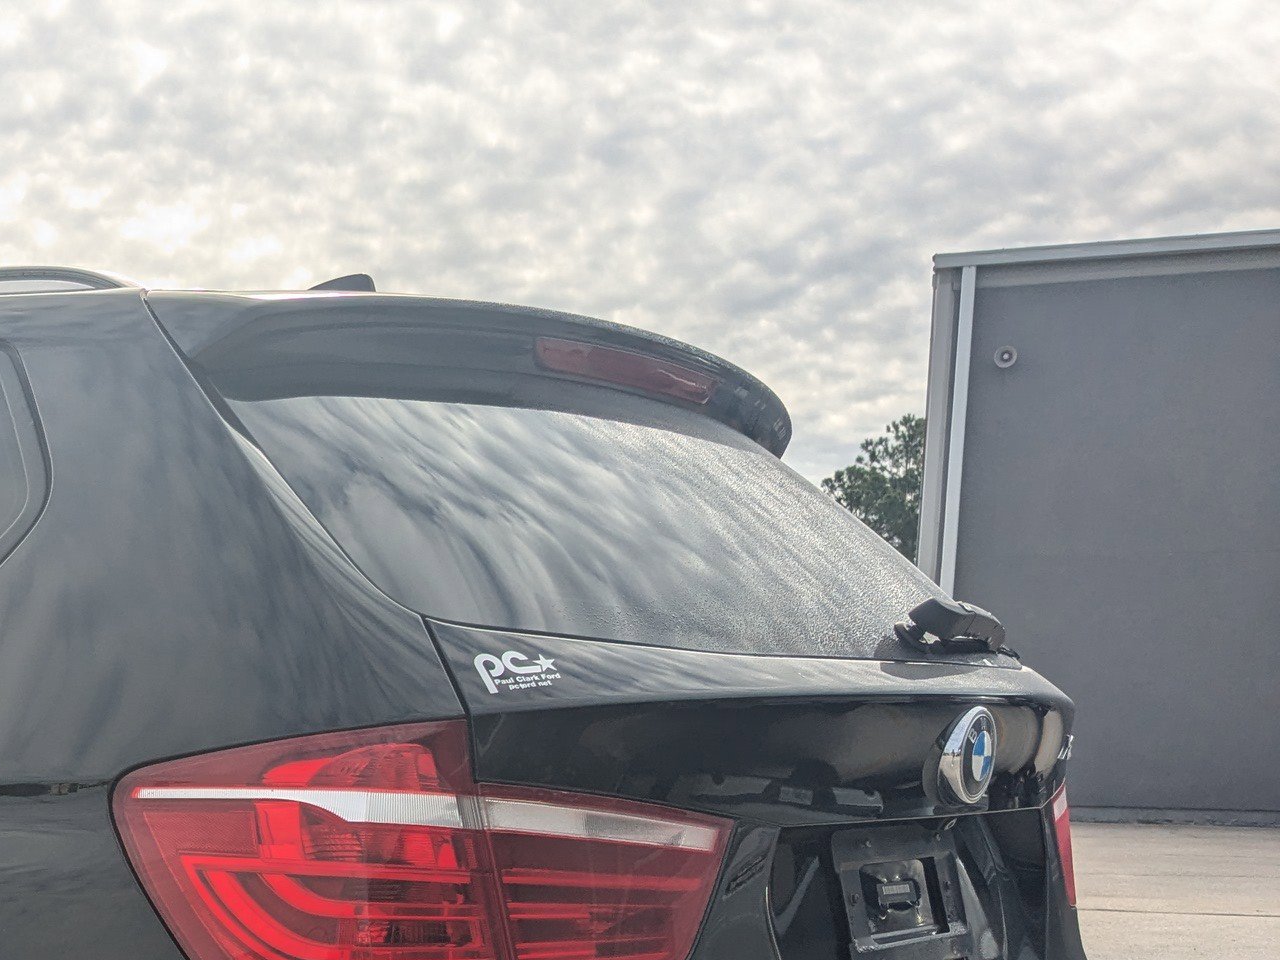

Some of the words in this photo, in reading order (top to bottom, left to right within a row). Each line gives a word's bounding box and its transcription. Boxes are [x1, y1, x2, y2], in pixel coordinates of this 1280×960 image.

[494, 677, 515, 686] Paul
[515, 674, 540, 683] Clark
[541, 673, 562, 681] Ford
